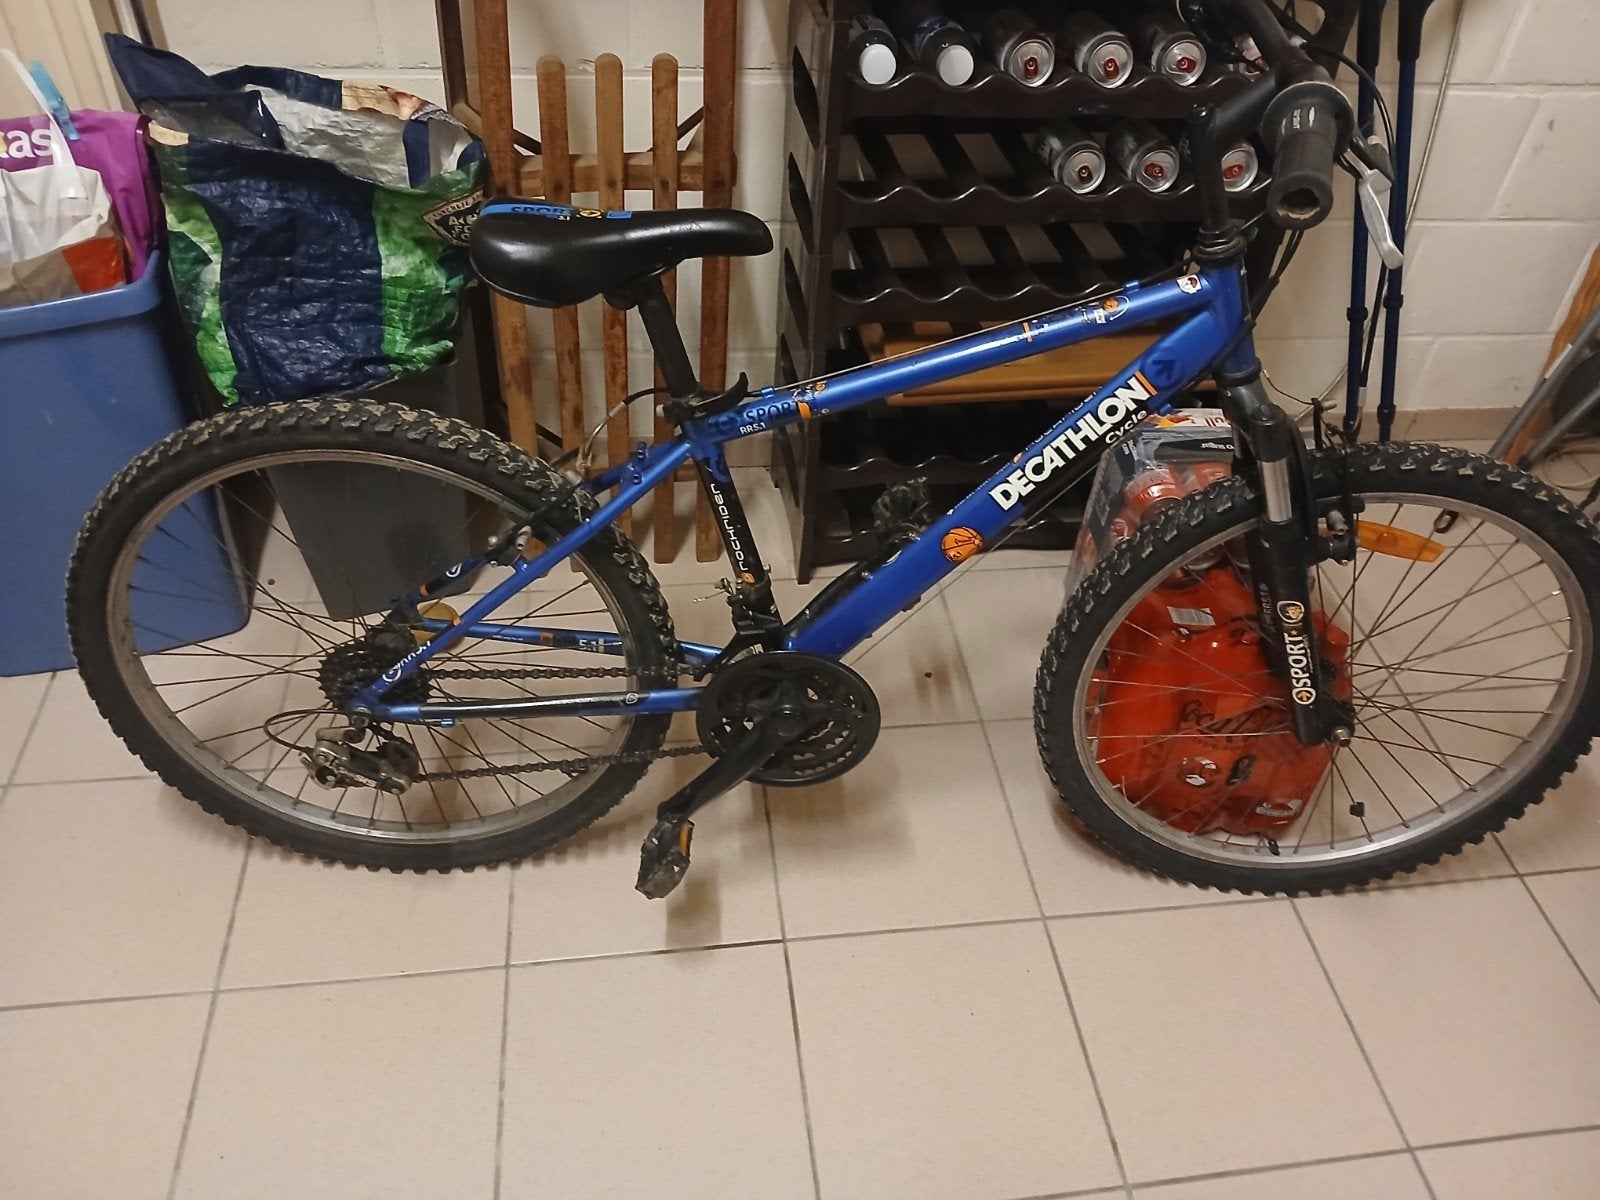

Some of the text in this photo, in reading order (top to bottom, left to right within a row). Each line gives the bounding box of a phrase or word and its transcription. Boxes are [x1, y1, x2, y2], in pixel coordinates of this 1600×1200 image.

[988, 376, 1151, 511] DECATHLON
[1105, 410, 1148, 444] Cycle
[1284, 632, 1312, 689] SPORT
